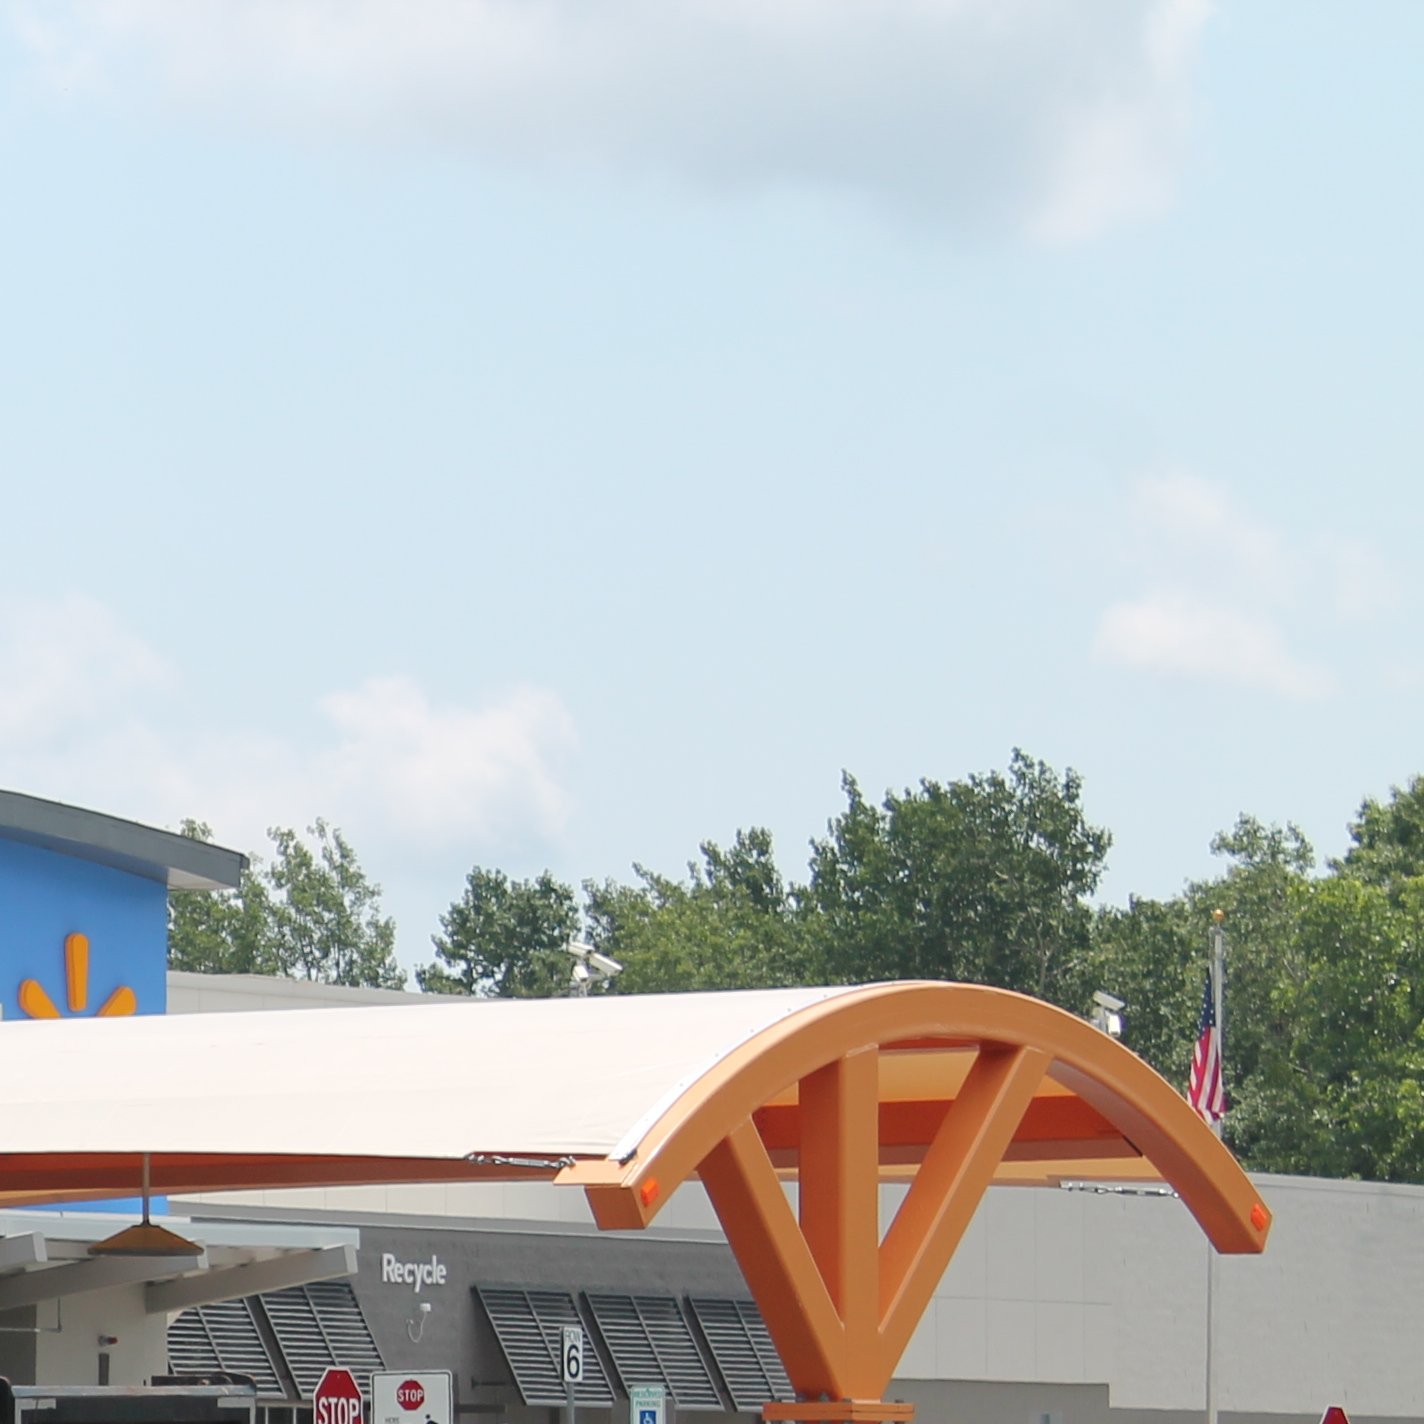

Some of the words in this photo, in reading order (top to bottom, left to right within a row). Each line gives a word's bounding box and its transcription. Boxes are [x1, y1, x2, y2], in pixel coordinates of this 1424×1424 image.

[382, 1253, 446, 1293] Recycle
[565, 1330, 581, 1343] ROW
[566, 1344, 580, 1379] 6
[397, 1389, 424, 1402] STOP
